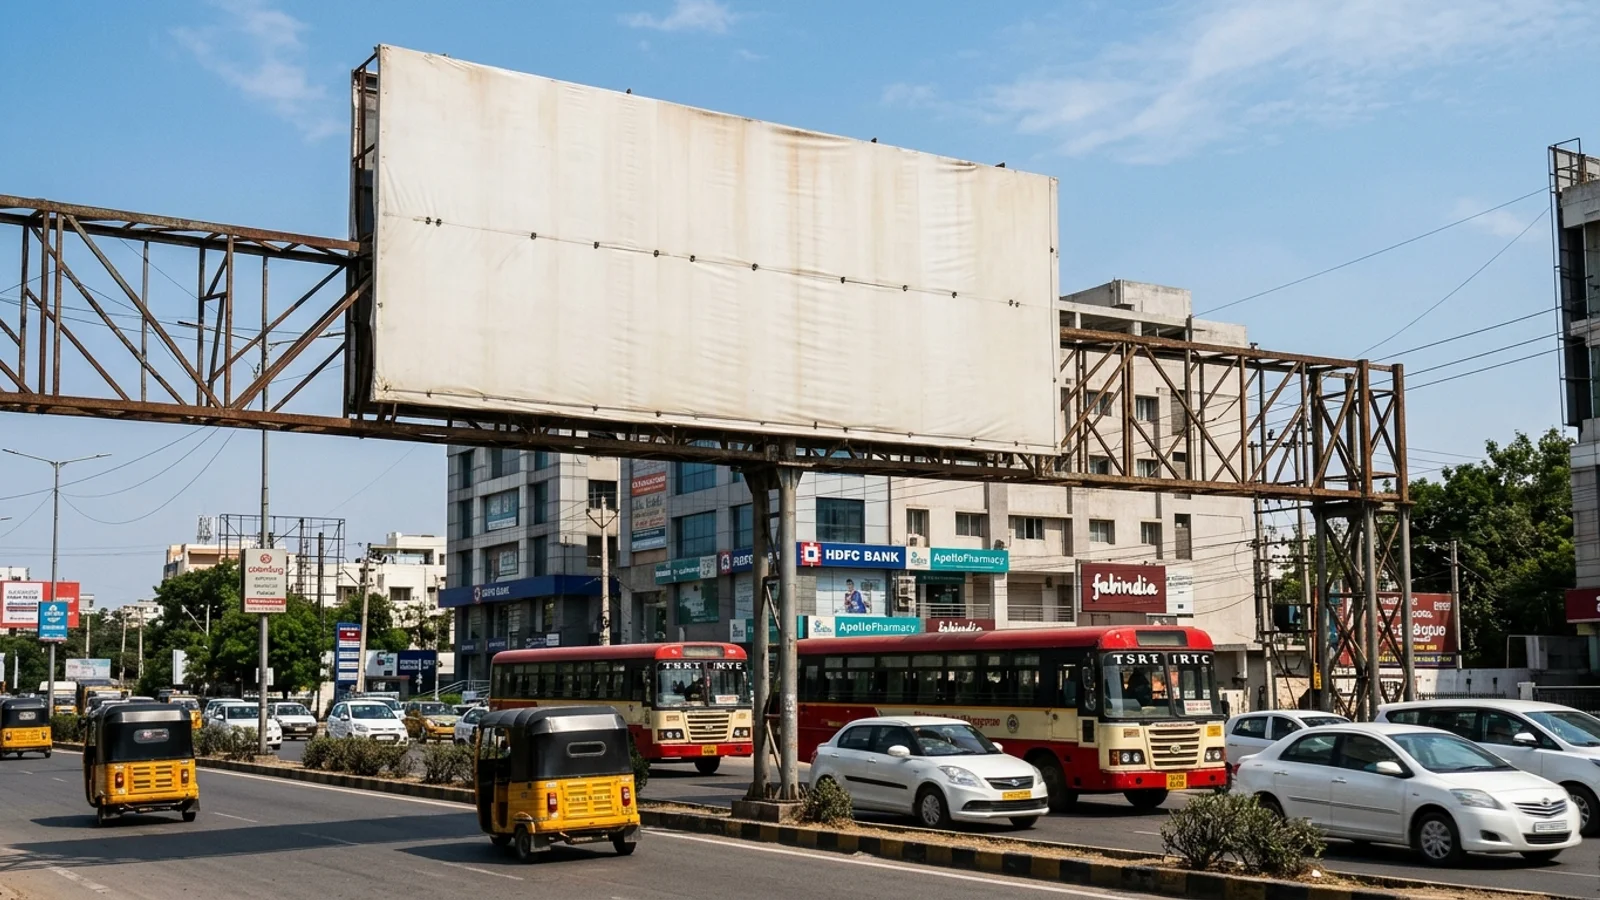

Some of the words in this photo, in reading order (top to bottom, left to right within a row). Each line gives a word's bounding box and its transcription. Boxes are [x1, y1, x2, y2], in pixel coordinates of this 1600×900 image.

[825, 549, 860, 561] HDFC
[864, 550, 900, 563] BANK
[1091, 572, 1159, 601] fabindia
